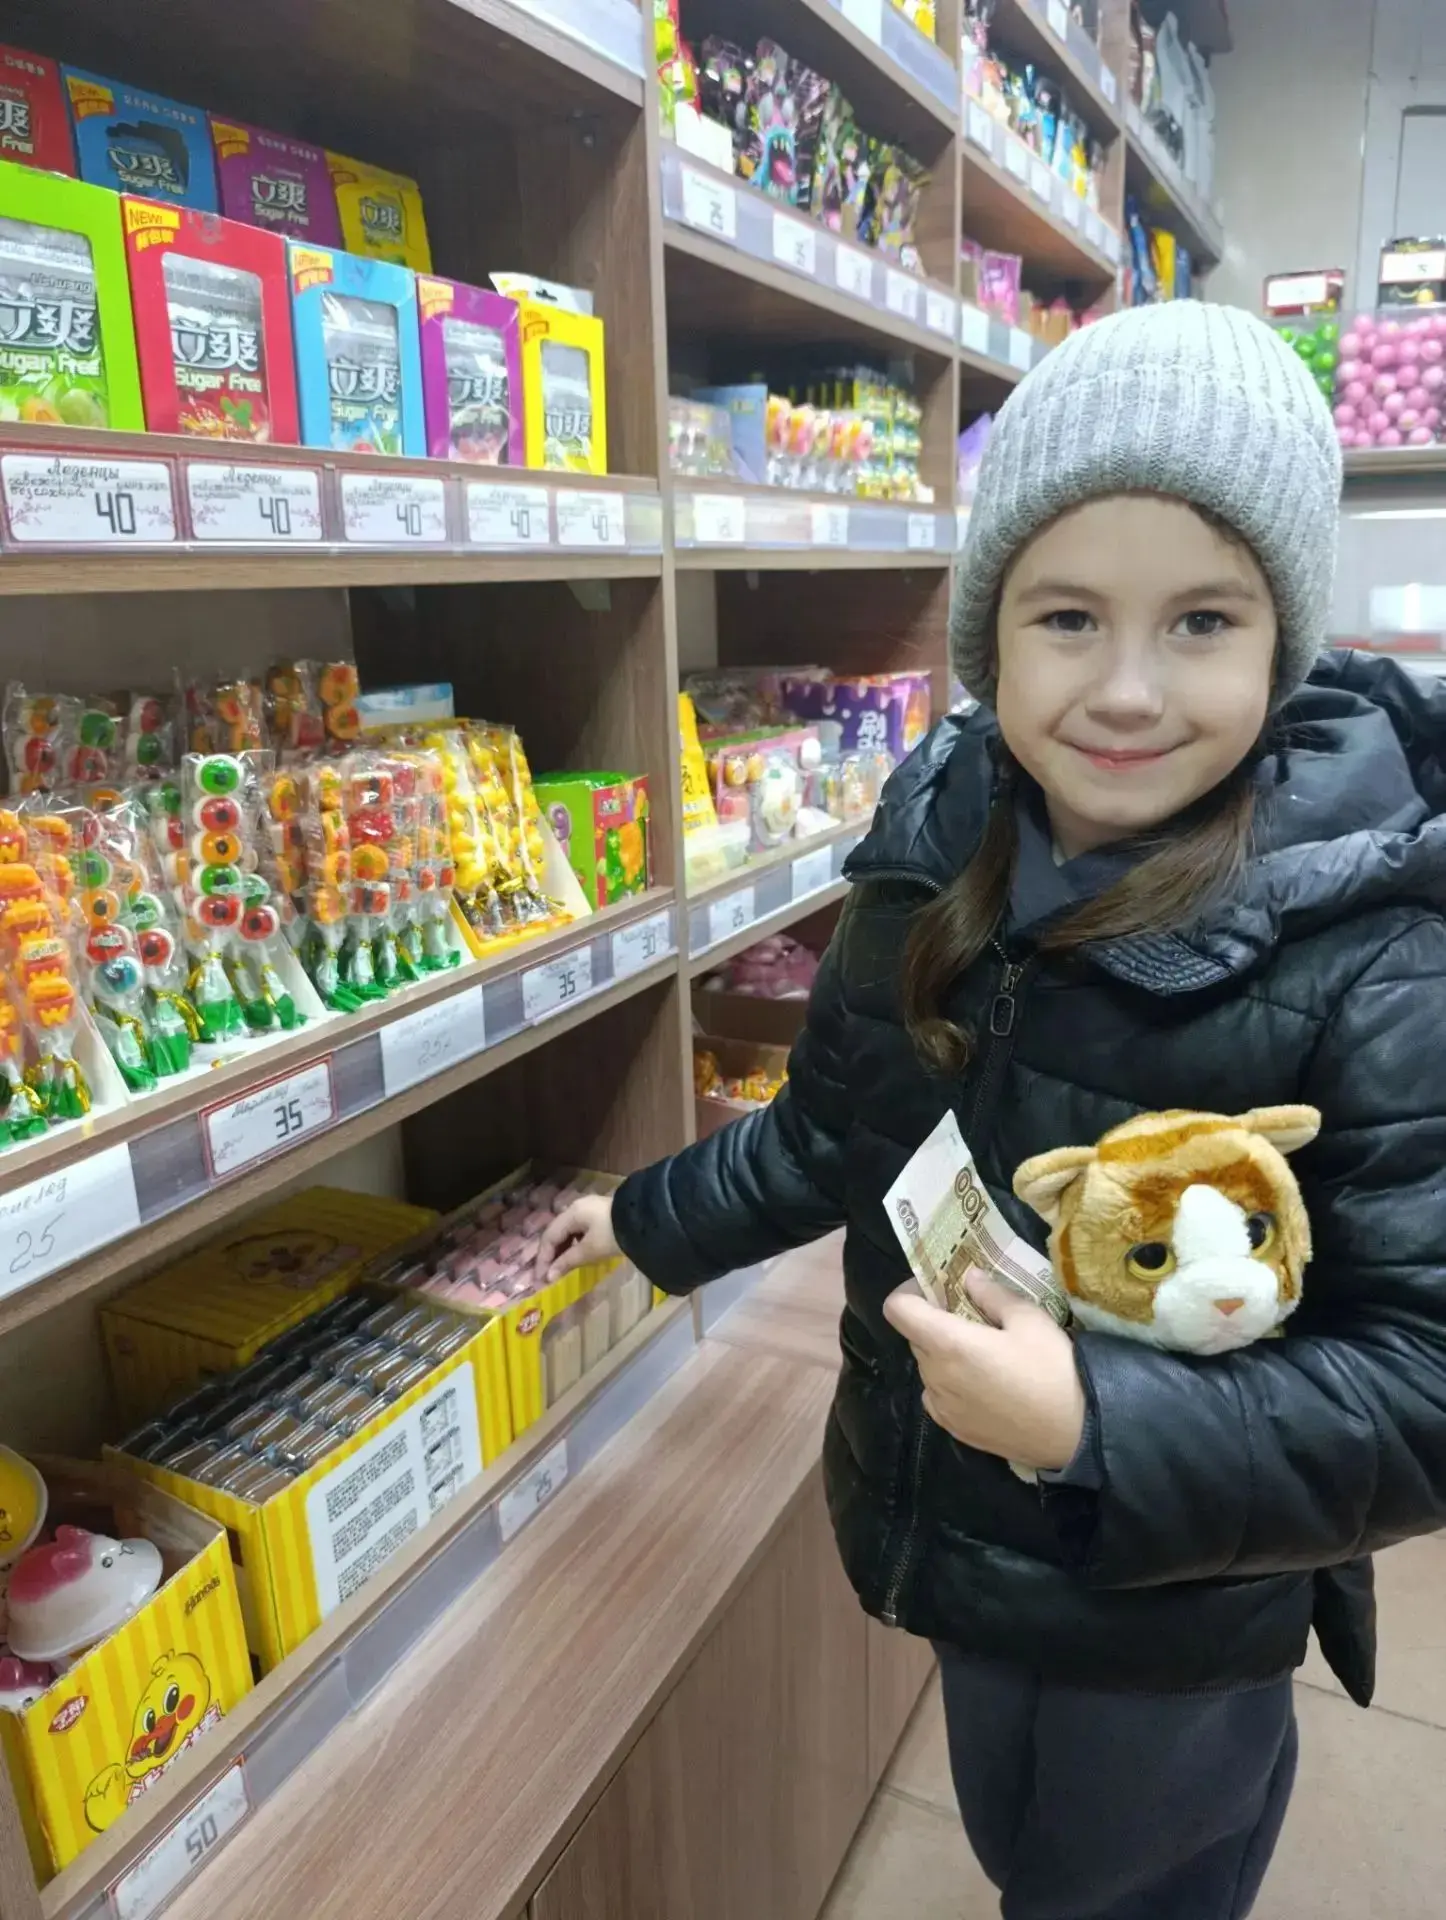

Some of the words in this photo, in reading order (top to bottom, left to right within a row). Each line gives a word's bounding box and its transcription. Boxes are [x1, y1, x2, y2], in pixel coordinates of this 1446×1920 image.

[108, 146, 177, 182] 立爽
[251, 174, 308, 212] 立爽
[128, 209, 164, 225] NEW!
[171, 318, 259, 372] 立爽
[174, 367, 225, 390] Sugar
[228, 374, 262, 393] Free
[328, 355, 400, 403] 立爽
[330, 402, 367, 421] Sugar
[94, 491, 137, 535] 40
[258, 496, 292, 535] 40
[396, 503, 423, 536] 40
[510, 509, 531, 539] 40
[592, 513, 610, 542] 40
[558, 969, 577, 1000] 35
[273, 1098, 304, 1139] 35
[953, 1166, 990, 1232] 100
[897, 1202, 920, 1239] 100
[9, 1212, 66, 1275] 25
[185, 1814, 219, 1865] 50
